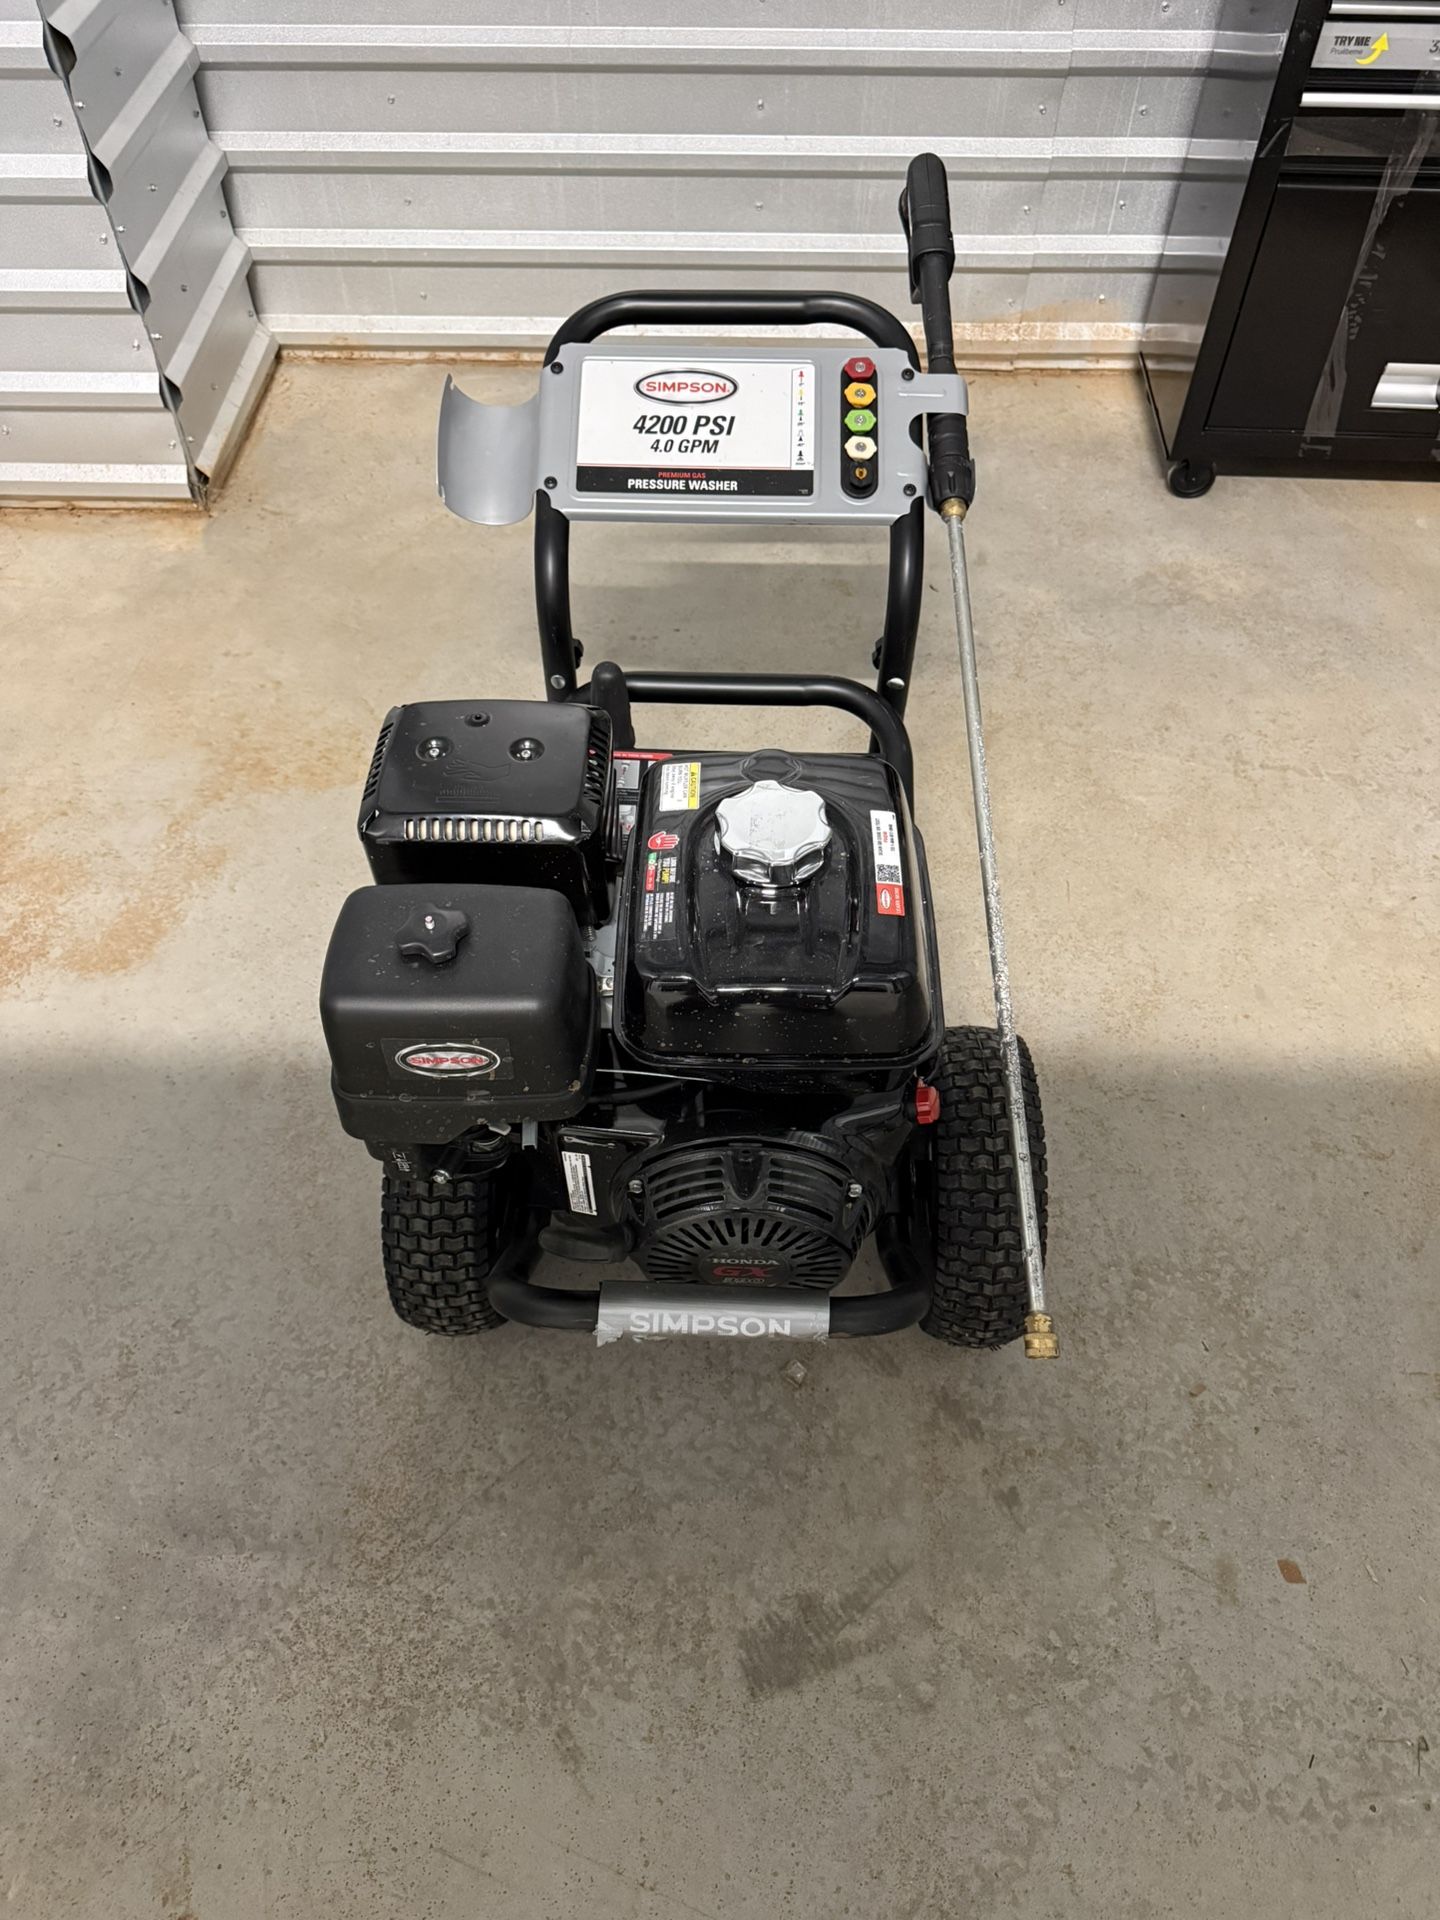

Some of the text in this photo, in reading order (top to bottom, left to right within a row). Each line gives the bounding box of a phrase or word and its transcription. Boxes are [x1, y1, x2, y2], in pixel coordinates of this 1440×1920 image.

[1333, 35, 1371, 46] TRY ME
[645, 381, 728, 393] SIMPSON
[633, 415, 736, 436] 4200 PSI
[650, 439, 719, 454] 4.0 GPM
[627, 479, 738, 491] PRESSURE WASHER
[410, 1056, 485, 1065] SIMPSON
[711, 1258, 780, 1266] HONDA
[712, 1266, 775, 1278] GX
[630, 1311, 791, 1337] SIMPSON
